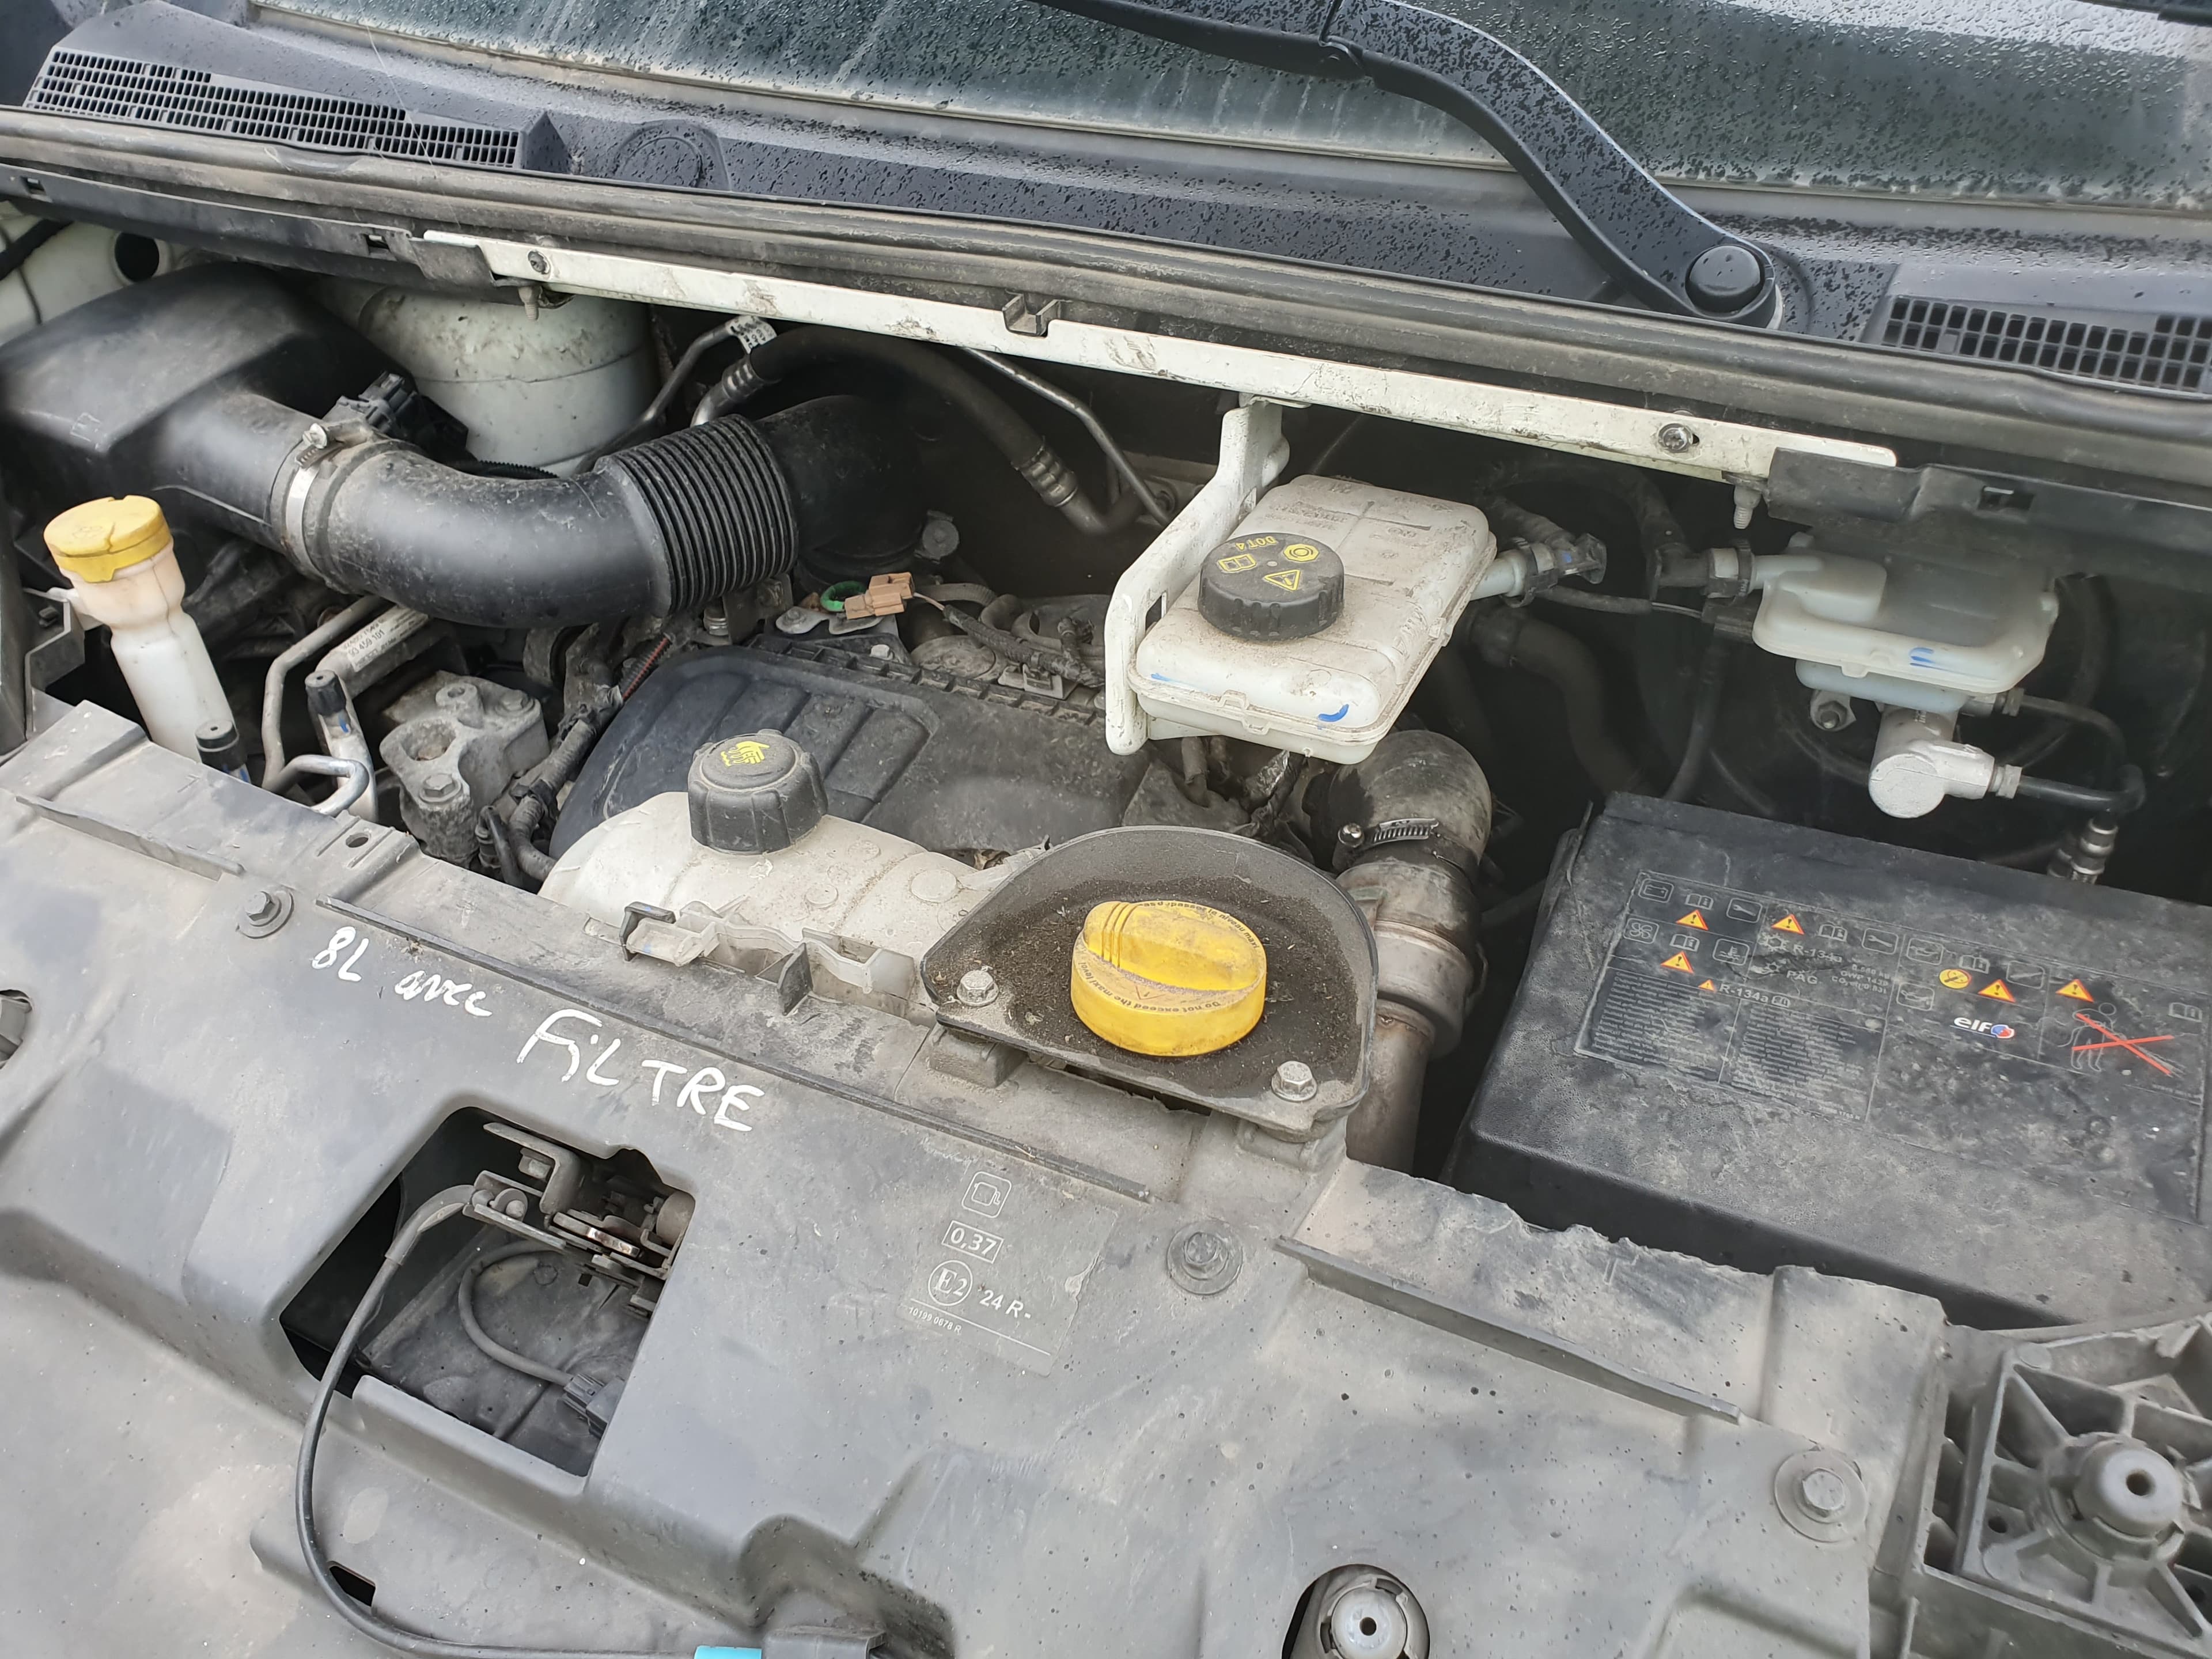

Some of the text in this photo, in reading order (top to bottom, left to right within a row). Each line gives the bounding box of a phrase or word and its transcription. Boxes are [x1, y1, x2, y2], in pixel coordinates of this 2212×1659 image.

[1219, 913, 1245, 932] niveau
[1244, 932, 1260, 949] maxi
[1078, 961, 1094, 983] level
[1787, 970, 1818, 984] PAG
[1092, 979, 1113, 996] maxi
[1719, 983, 1769, 1003] R-134a
[1113, 995, 1132, 1006] the
[1134, 1003, 1180, 1013] exceed
[1953, 1017, 1993, 1032] elf
[950, 1227, 997, 1256] 0,37
[979, 1290, 1005, 1311] 24
